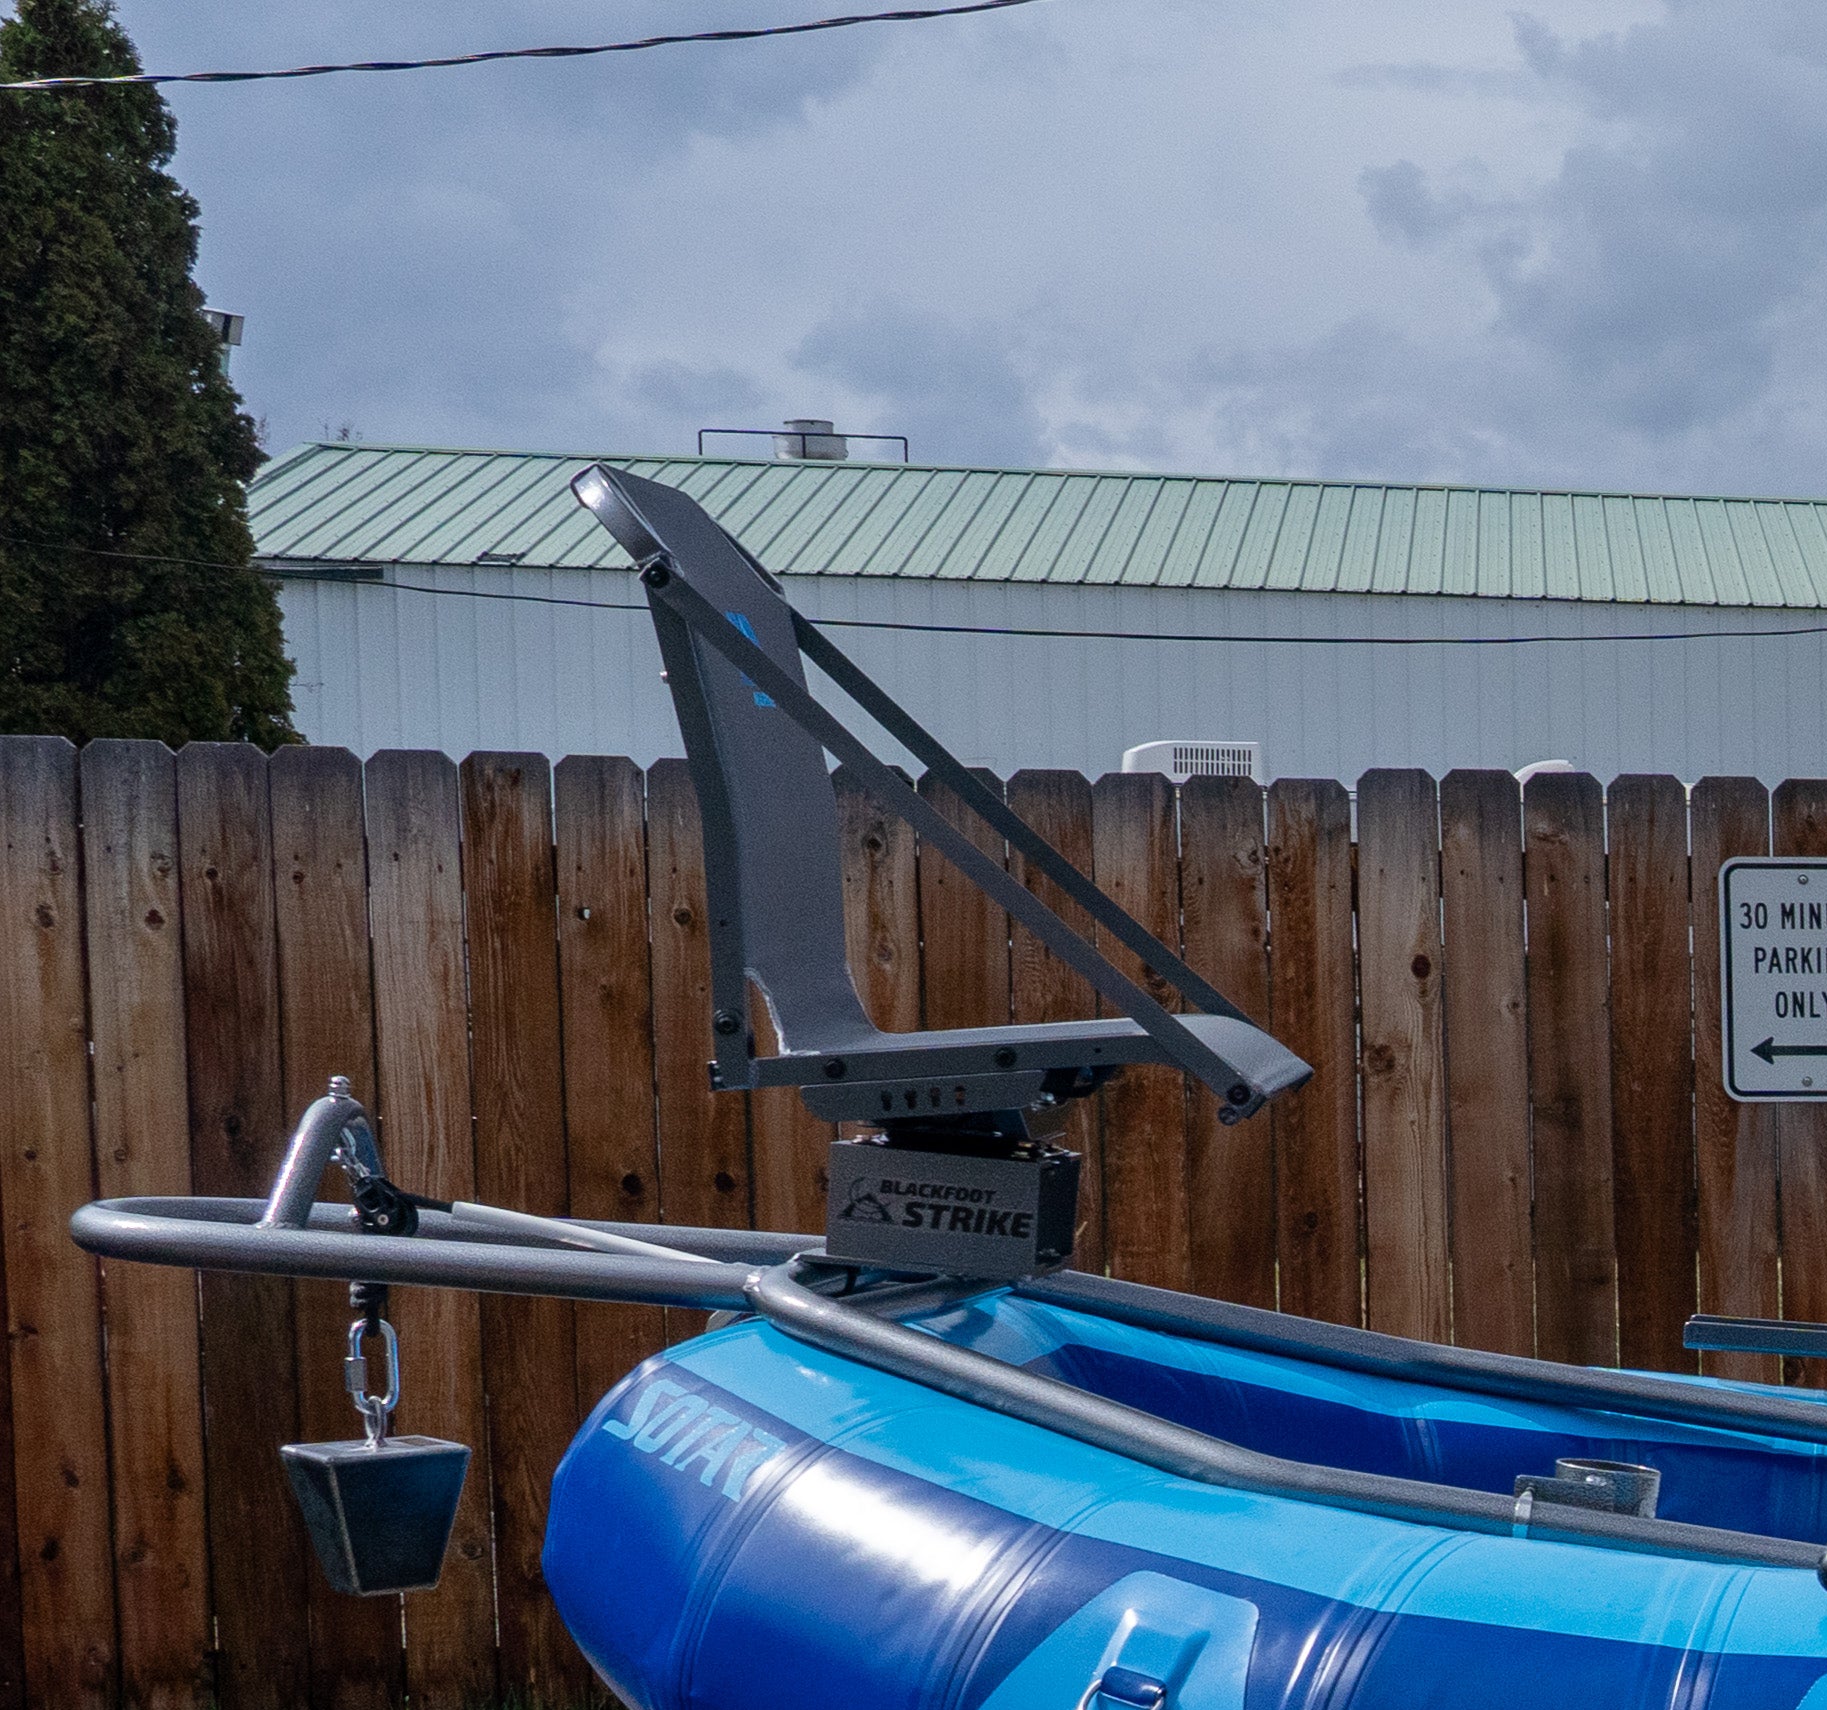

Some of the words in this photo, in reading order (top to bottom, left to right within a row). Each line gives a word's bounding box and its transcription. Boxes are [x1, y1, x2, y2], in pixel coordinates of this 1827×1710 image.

[1739, 902, 1768, 930] 30
[879, 1179, 998, 1205] BLACKFOOT
[901, 1200, 1035, 1240] STRIKE
